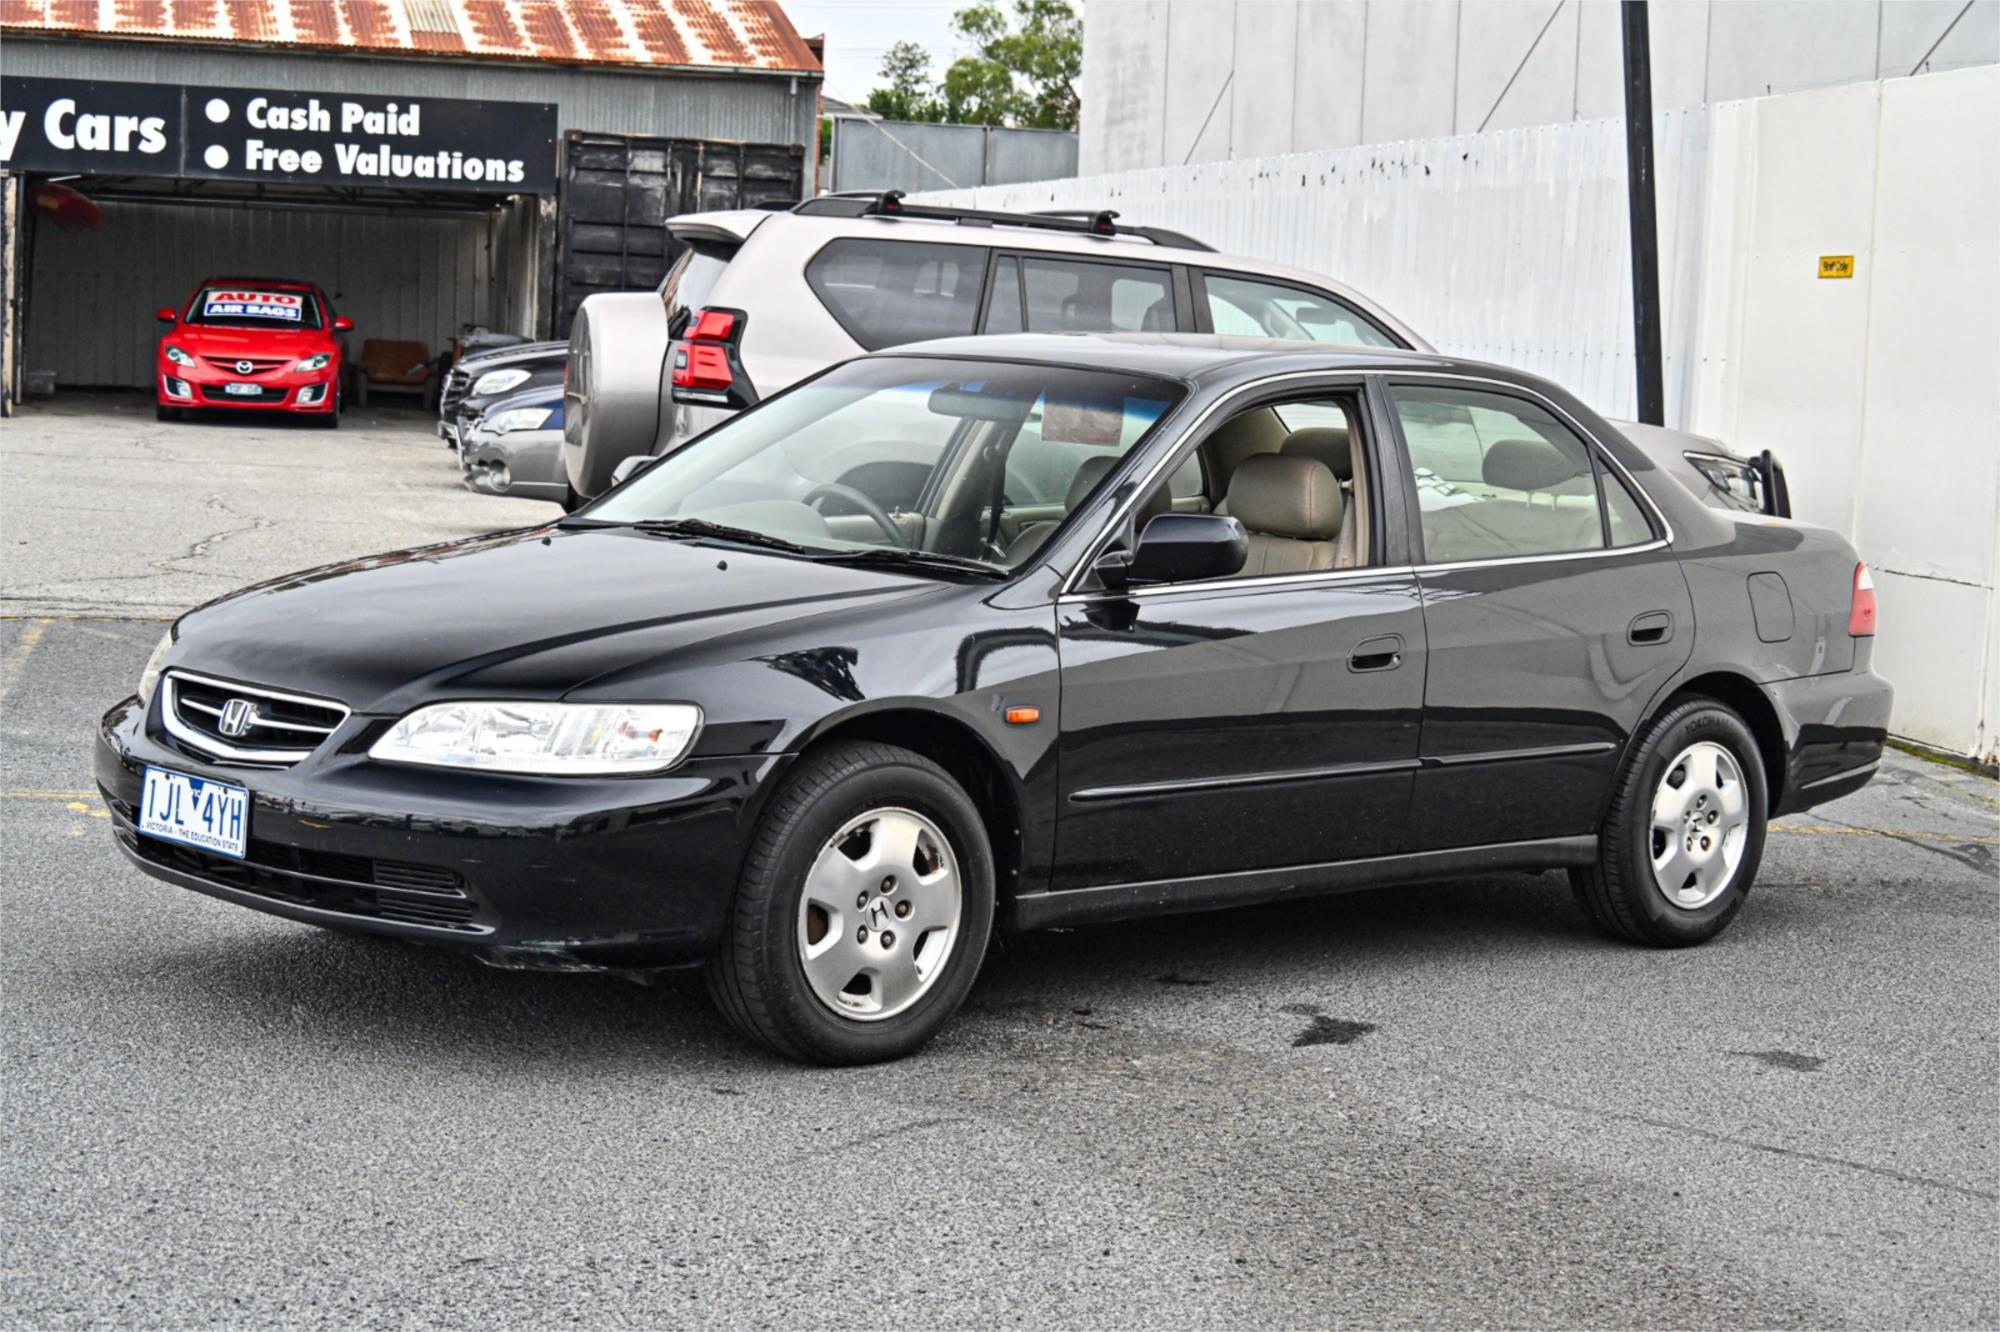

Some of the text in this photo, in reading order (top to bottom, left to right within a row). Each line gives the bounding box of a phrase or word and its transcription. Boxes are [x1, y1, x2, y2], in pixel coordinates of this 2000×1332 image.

[44, 98, 167, 154] Cars
[247, 98, 420, 136] Cash Paid
[246, 139, 525, 183] Free Valuations
[210, 304, 297, 317] AIR BAGS
[215, 292, 297, 304] AUTO
[148, 779, 242, 841] 1JL 4YH
[146, 821, 173, 834] VICTORIA
[179, 828, 190, 839] THE
[190, 831, 221, 847] EDUCATION
[222, 842, 239, 852] STATE
